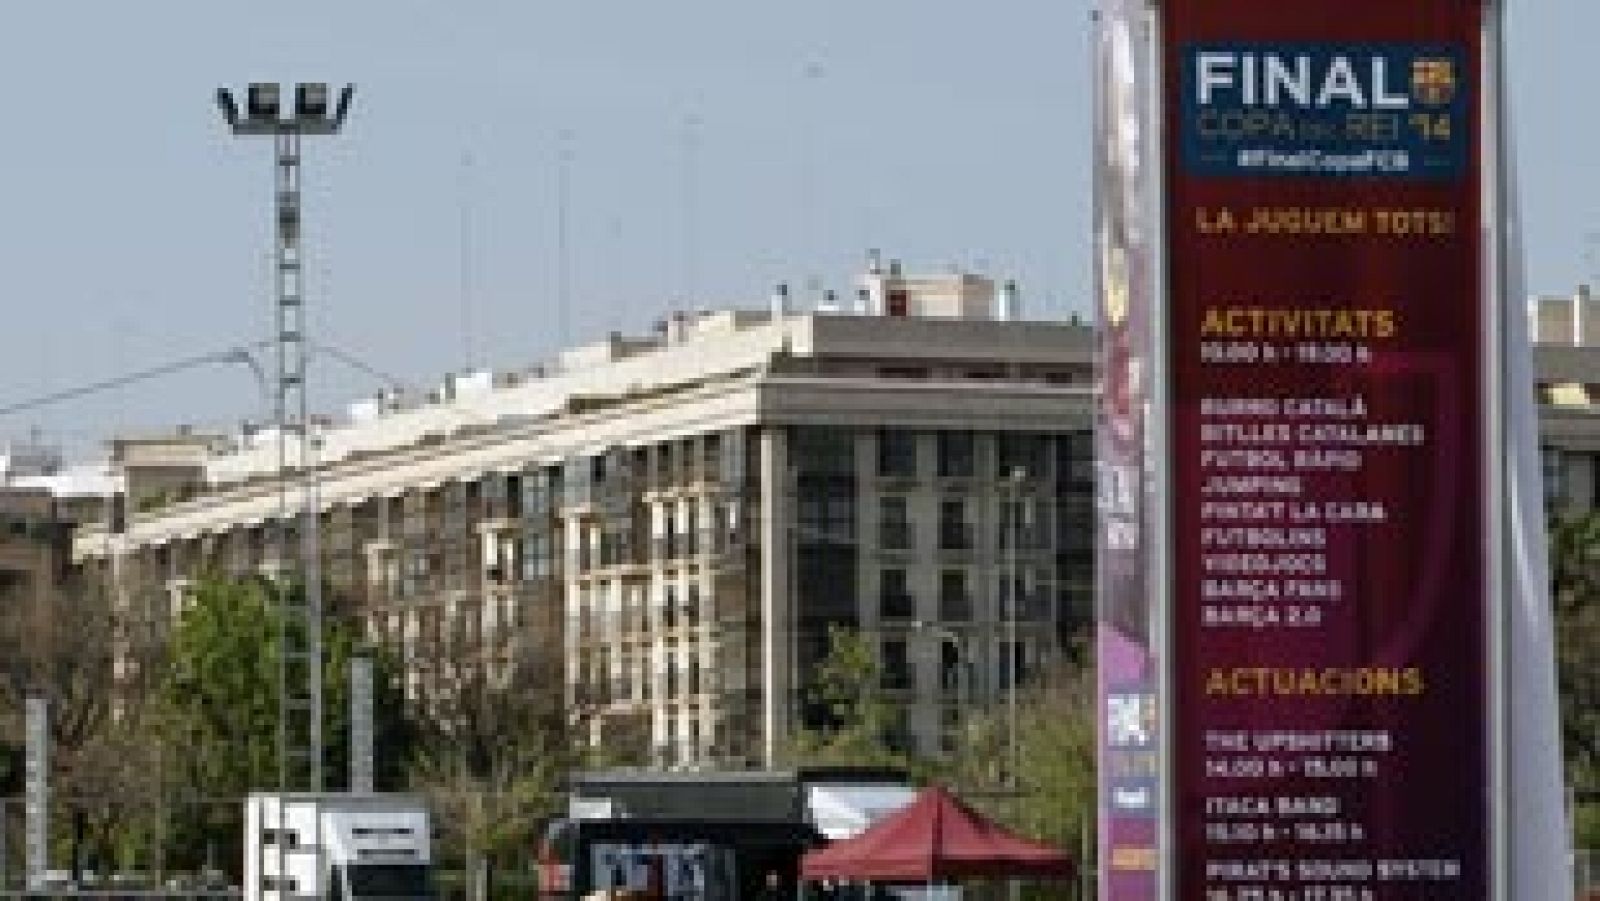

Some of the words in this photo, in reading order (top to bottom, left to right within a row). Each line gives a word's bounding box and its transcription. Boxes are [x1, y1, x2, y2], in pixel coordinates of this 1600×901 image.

[1197, 53, 1408, 107] FINAL
[1197, 111, 1295, 140] COPA
[1238, 150, 1409, 172] #FinalCopaFCB
[1196, 207, 1236, 233] LA
[1244, 207, 1366, 234] JUGUEM
[1201, 308, 1396, 337] ACTIVITATS
[1201, 398, 1279, 417] BURRO
[1201, 424, 1291, 444] BITLLES
[1298, 424, 1425, 445] CATALANES
[1201, 450, 1287, 469] FUTBOL
[1201, 476, 1303, 496] JUMPING
[1289, 502, 1321, 521] LA
[1325, 502, 1386, 522] CARA
[1201, 528, 1326, 547] FUTBOLINS
[1202, 554, 1326, 573] VIDEOJOCS
[1202, 580, 1280, 601] BARÇA
[1202, 606, 1281, 629] BARÇA
[1206, 667, 1424, 695] ACTUACIONS
[1205, 731, 1248, 751] THE
[1206, 798, 1269, 817] ITACA
[1278, 797, 1338, 817] BAND
[1300, 859, 1372, 880] SOUND
[1376, 859, 1461, 880] SYSTEM
